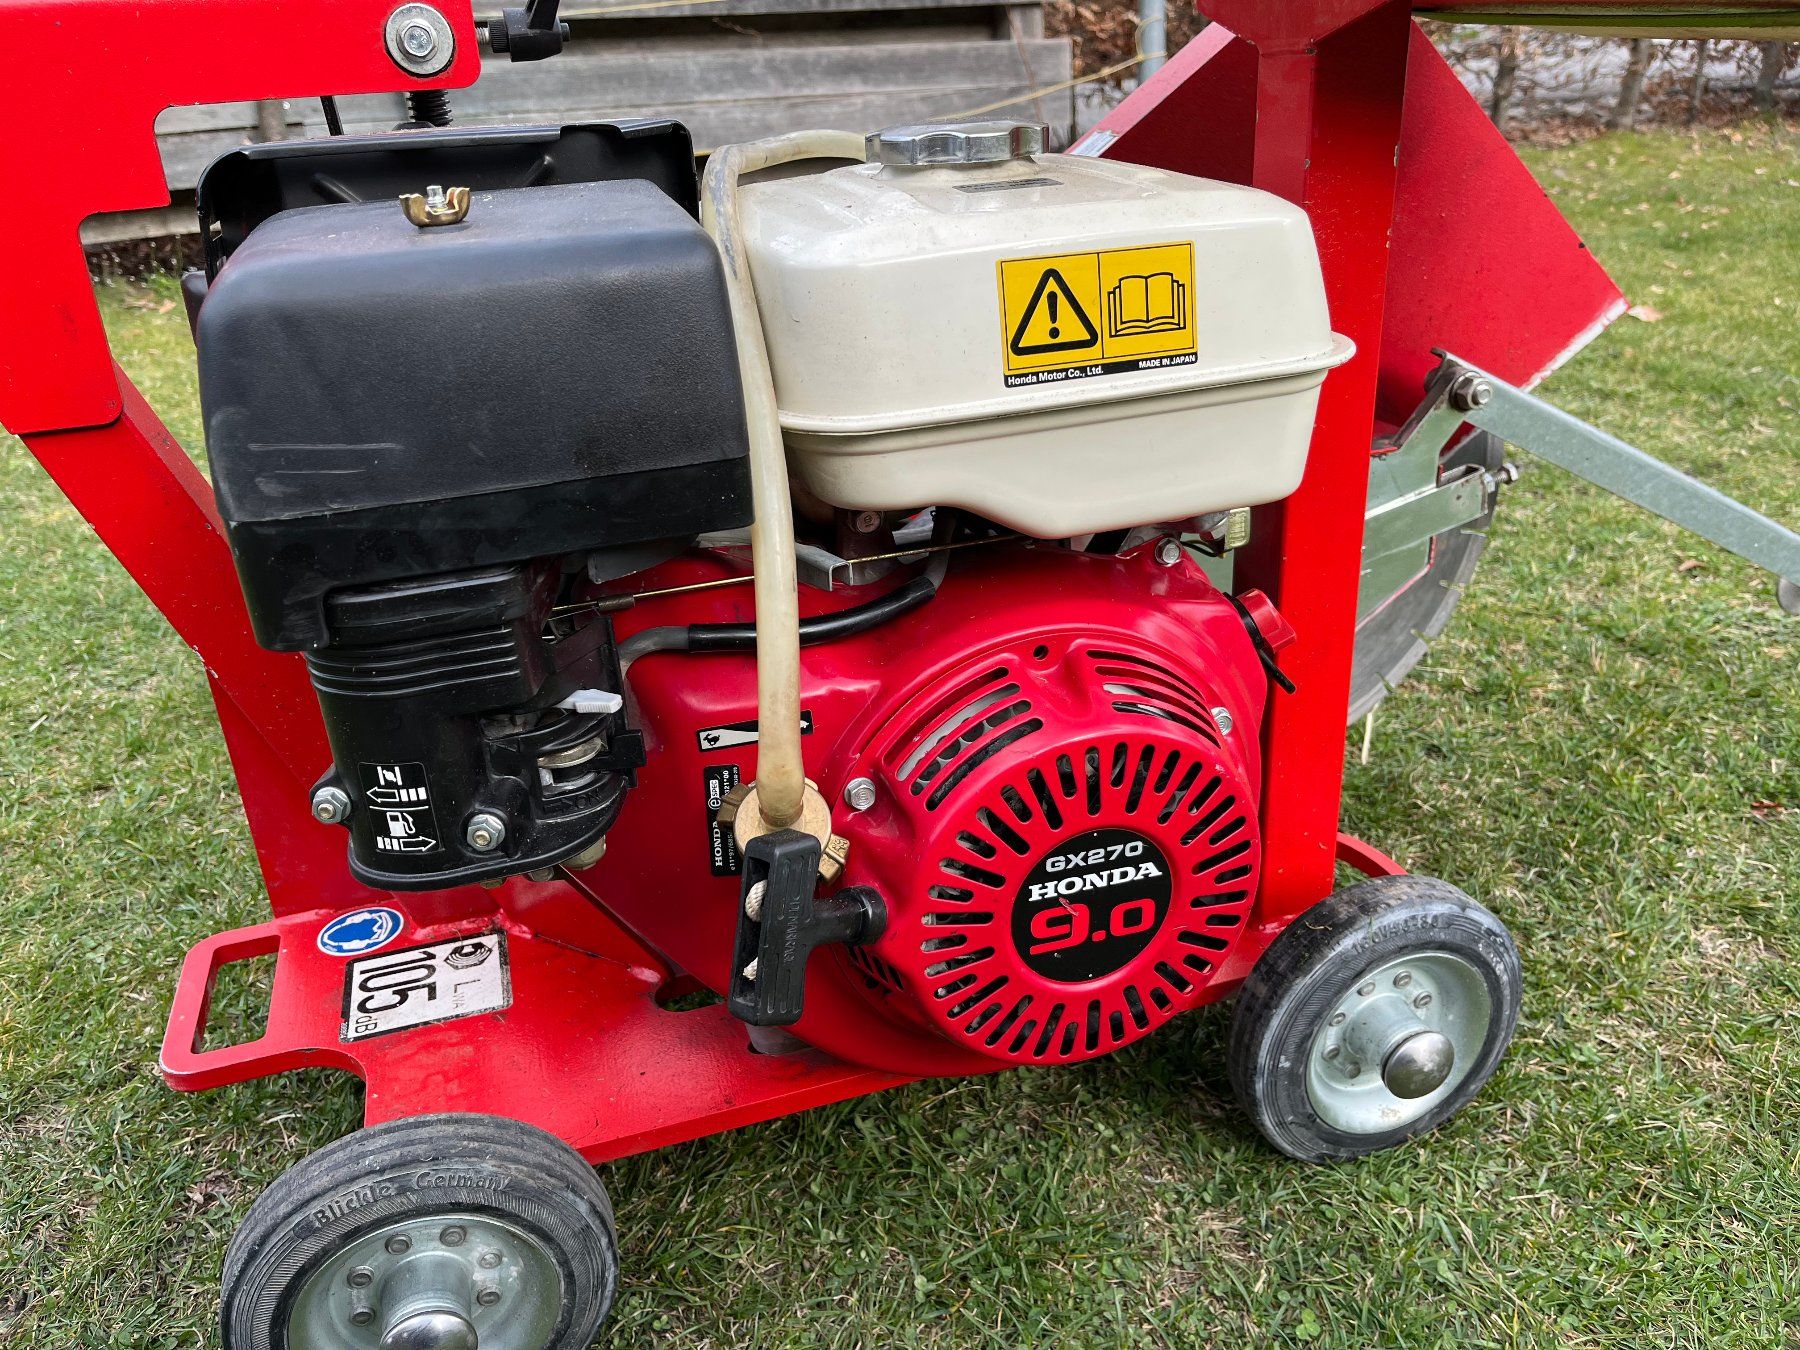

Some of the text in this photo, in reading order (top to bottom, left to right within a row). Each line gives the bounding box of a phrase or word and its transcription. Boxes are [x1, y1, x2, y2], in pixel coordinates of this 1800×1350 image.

[1008, 374, 1037, 386] Honda
[1039, 371, 1066, 382] Motor
[1087, 366, 1104, 376] Ltd.
[1139, 354, 1196, 368] MADE IN JAPAN
[1045, 840, 1143, 873] GX270
[1028, 861, 1163, 902] HONDA
[1029, 898, 1156, 956] 9.0
[356, 950, 437, 1014] 105
[355, 1014, 378, 1034] dB
[312, 1171, 511, 1228] Blickle Germany
